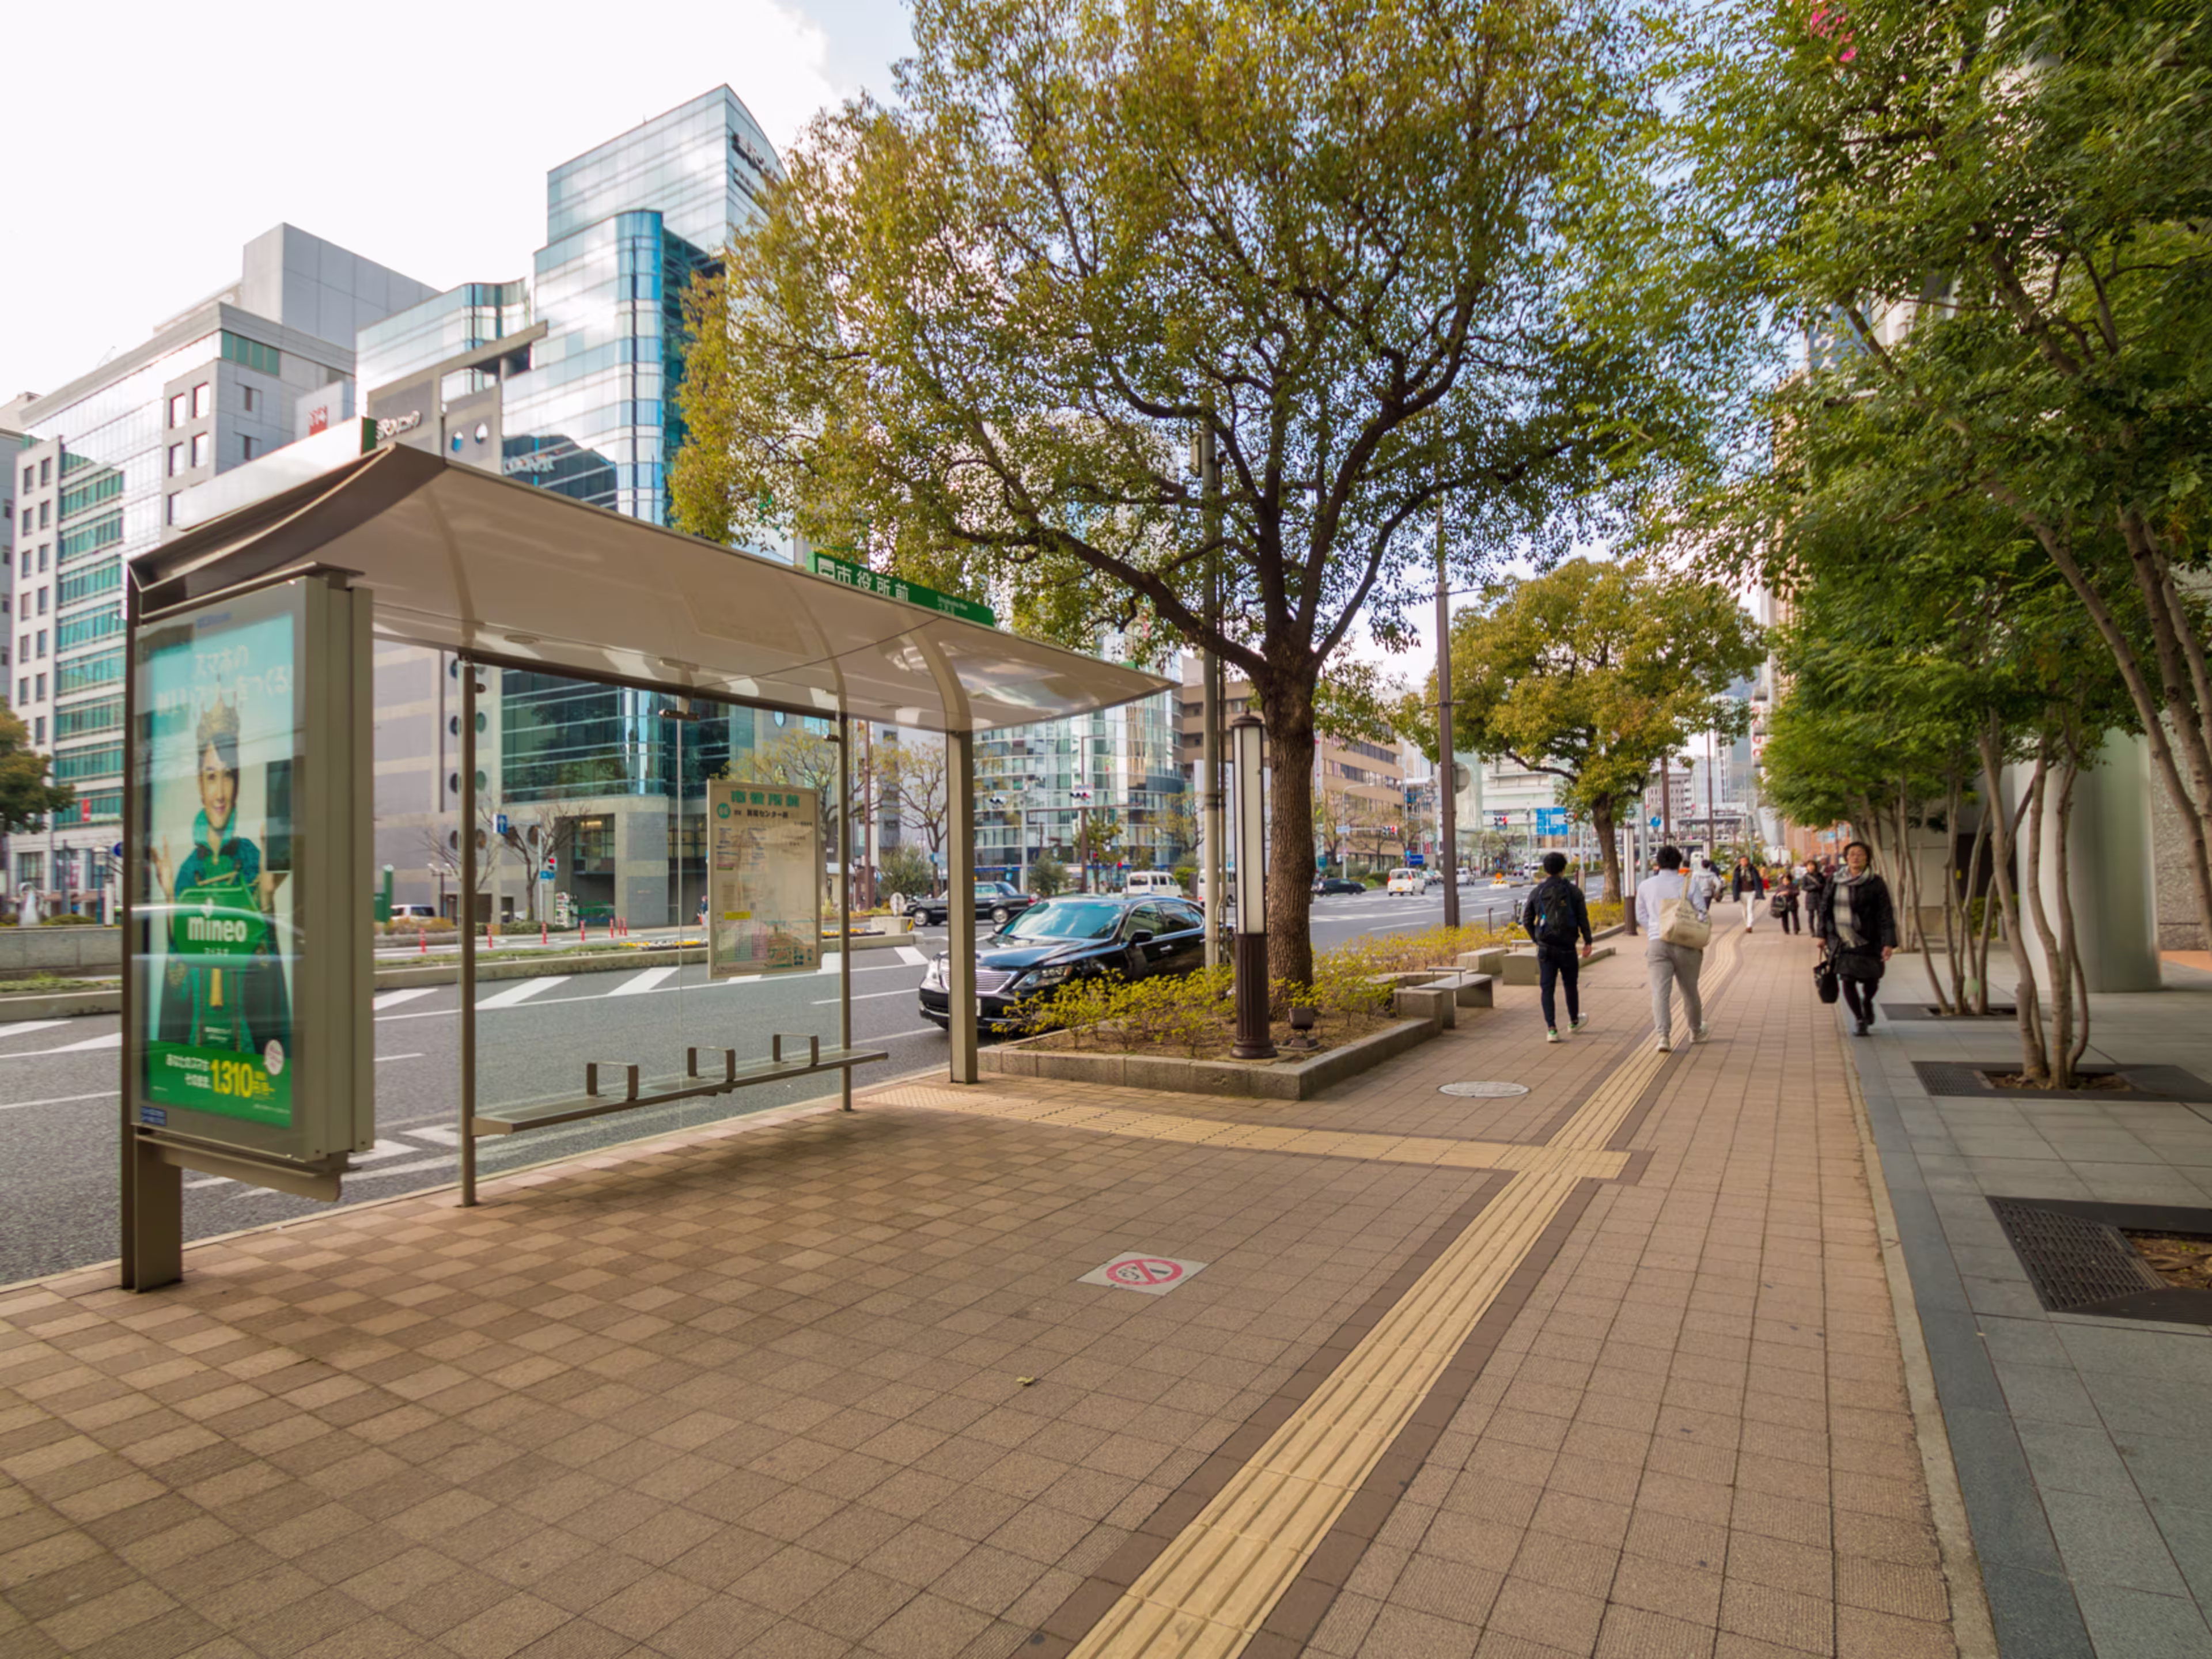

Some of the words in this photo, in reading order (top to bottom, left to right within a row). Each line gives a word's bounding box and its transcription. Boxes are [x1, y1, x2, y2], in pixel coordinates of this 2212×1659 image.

[836, 565, 908, 602] 市役所前
[187, 916, 247, 942] mineo
